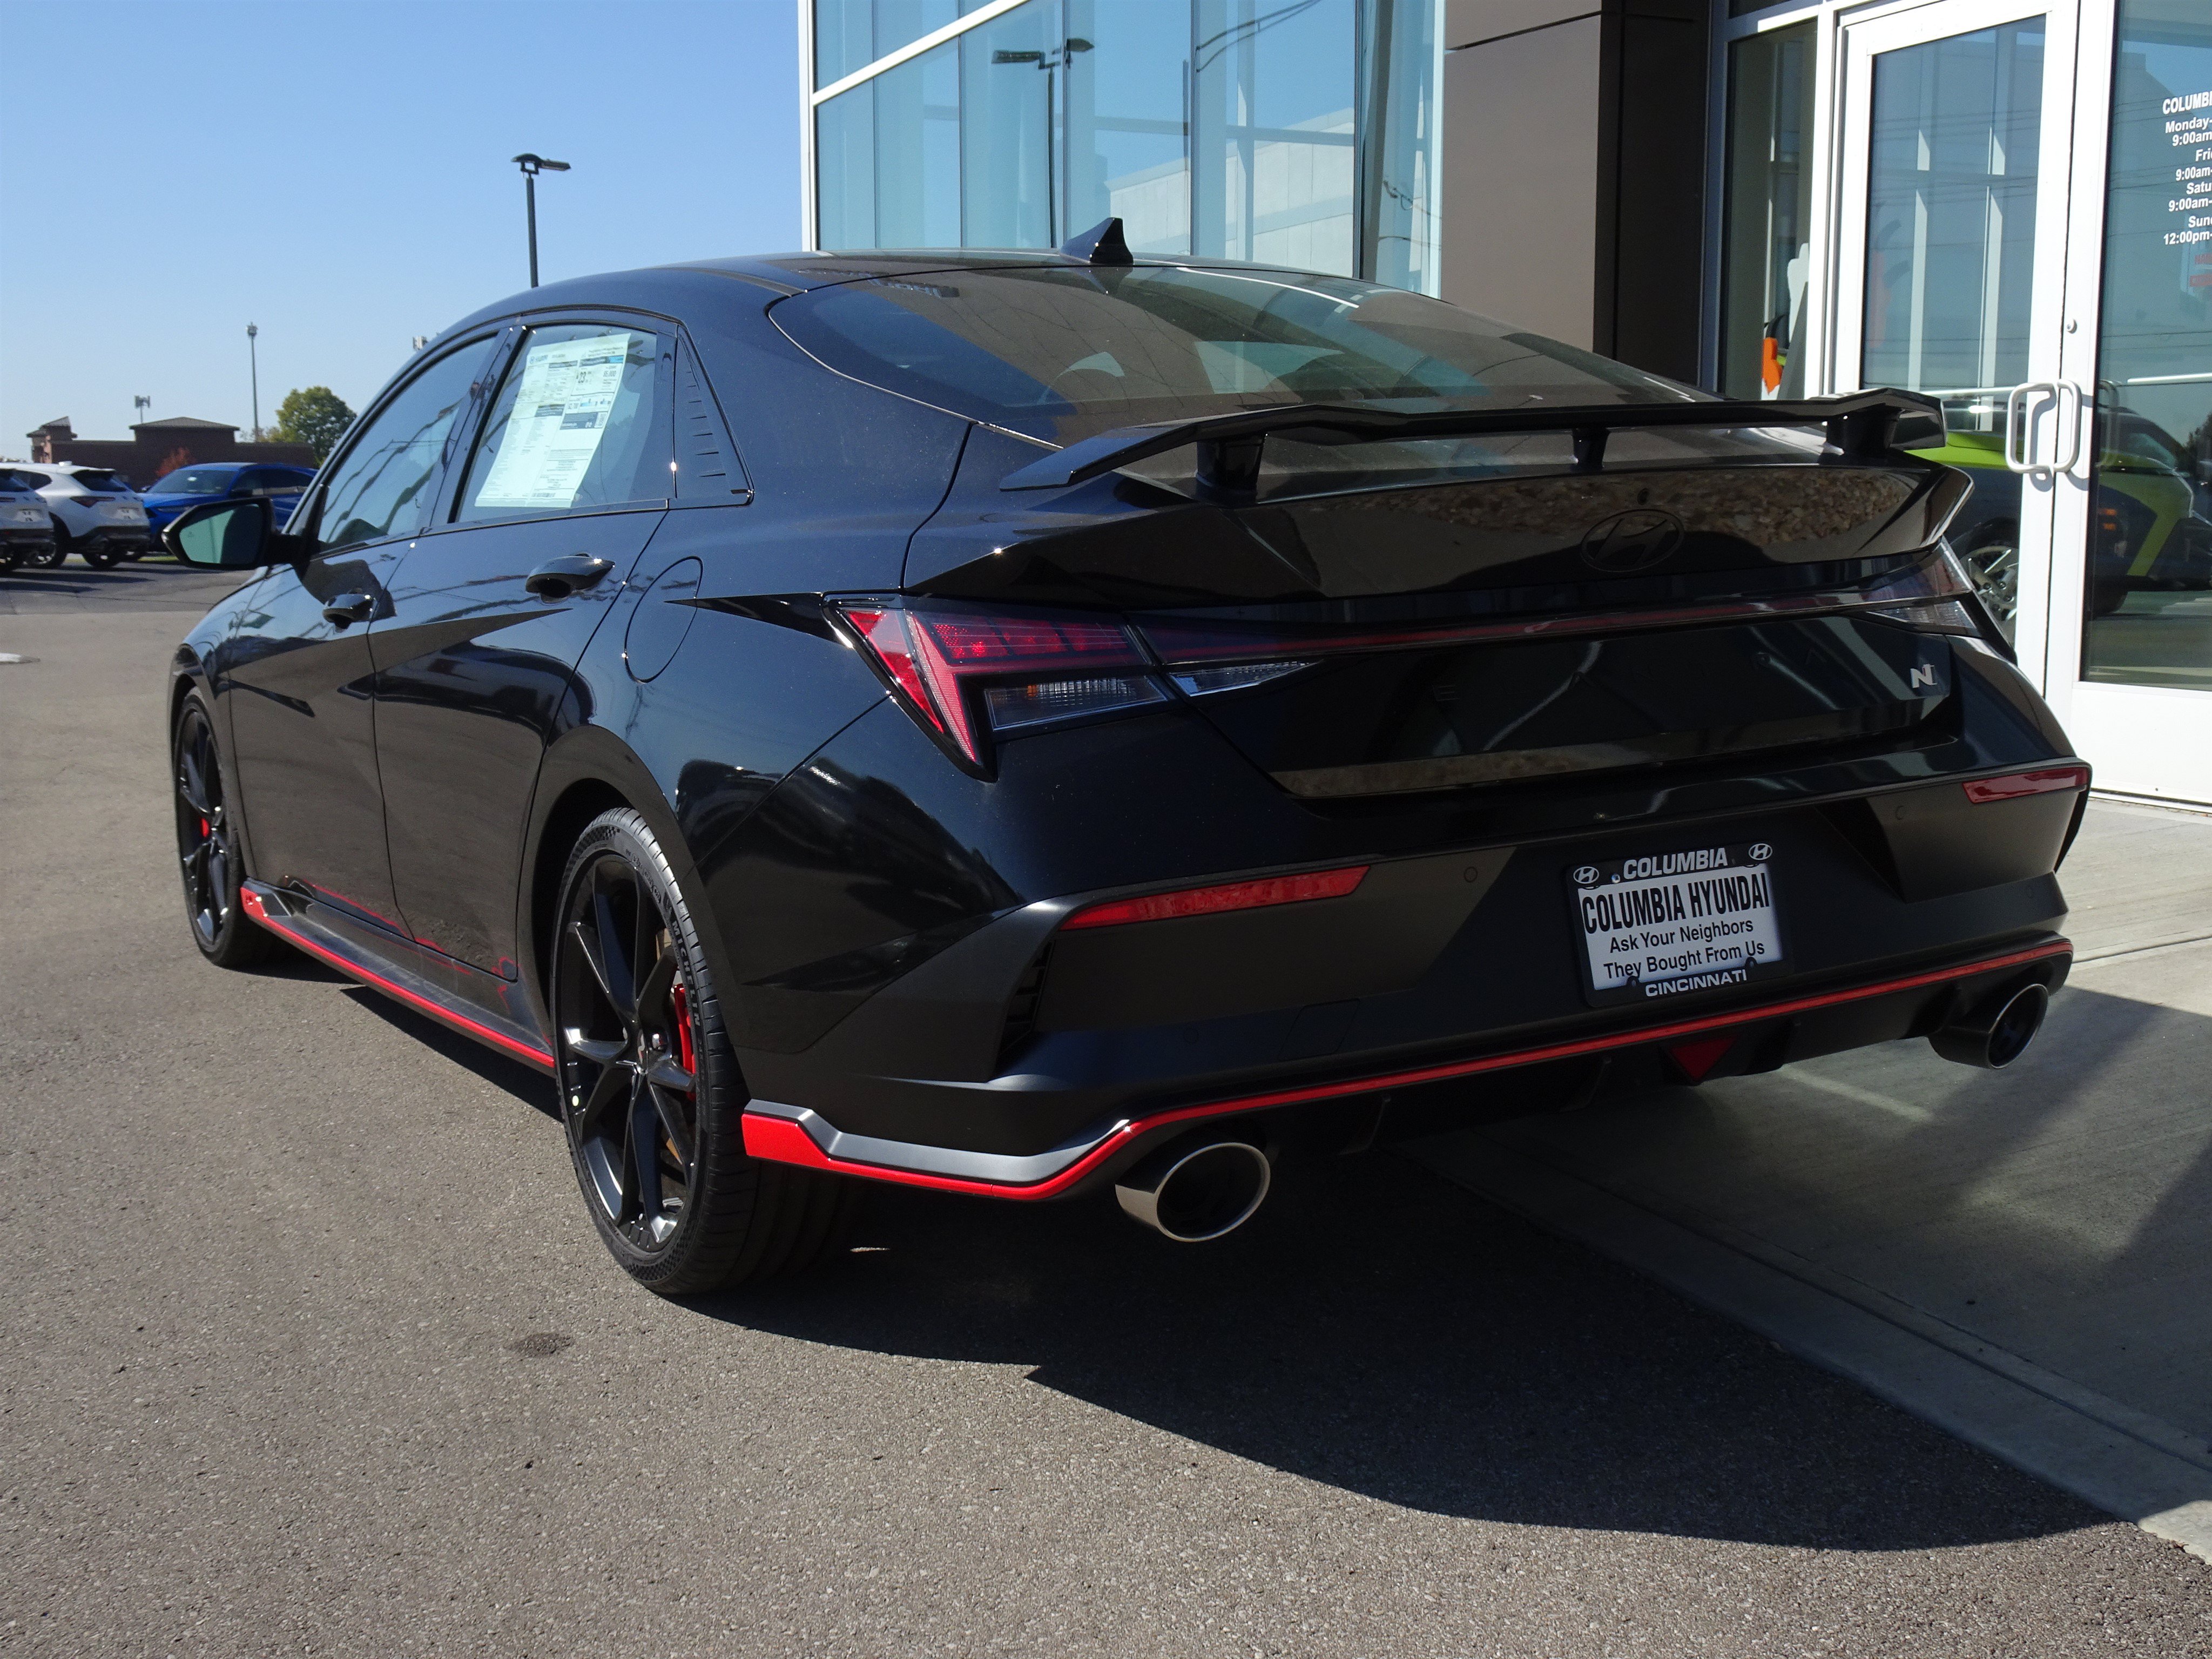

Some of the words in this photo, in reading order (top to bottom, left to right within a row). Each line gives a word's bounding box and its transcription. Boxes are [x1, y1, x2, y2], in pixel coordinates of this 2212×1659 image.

[2168, 197, 2212, 212] 9:00am-
[1910, 664, 1937, 688] N
[1623, 847, 1728, 879] COLUMBIA
[1582, 885, 1686, 934] COLUMBIA
[1688, 873, 1770, 918] HYUNDAI
[1610, 935, 1638, 954] Ask
[1640, 931, 1675, 948] Your
[1680, 920, 1754, 943] Neighbors
[672, 920, 700, 1026] MICHELIN
[1603, 962, 1641, 979] They
[1646, 950, 1701, 972] Bought
[1705, 945, 1742, 963] From
[1745, 941, 1765, 956] Us
[1645, 969, 1747, 996] CINCINNATI
